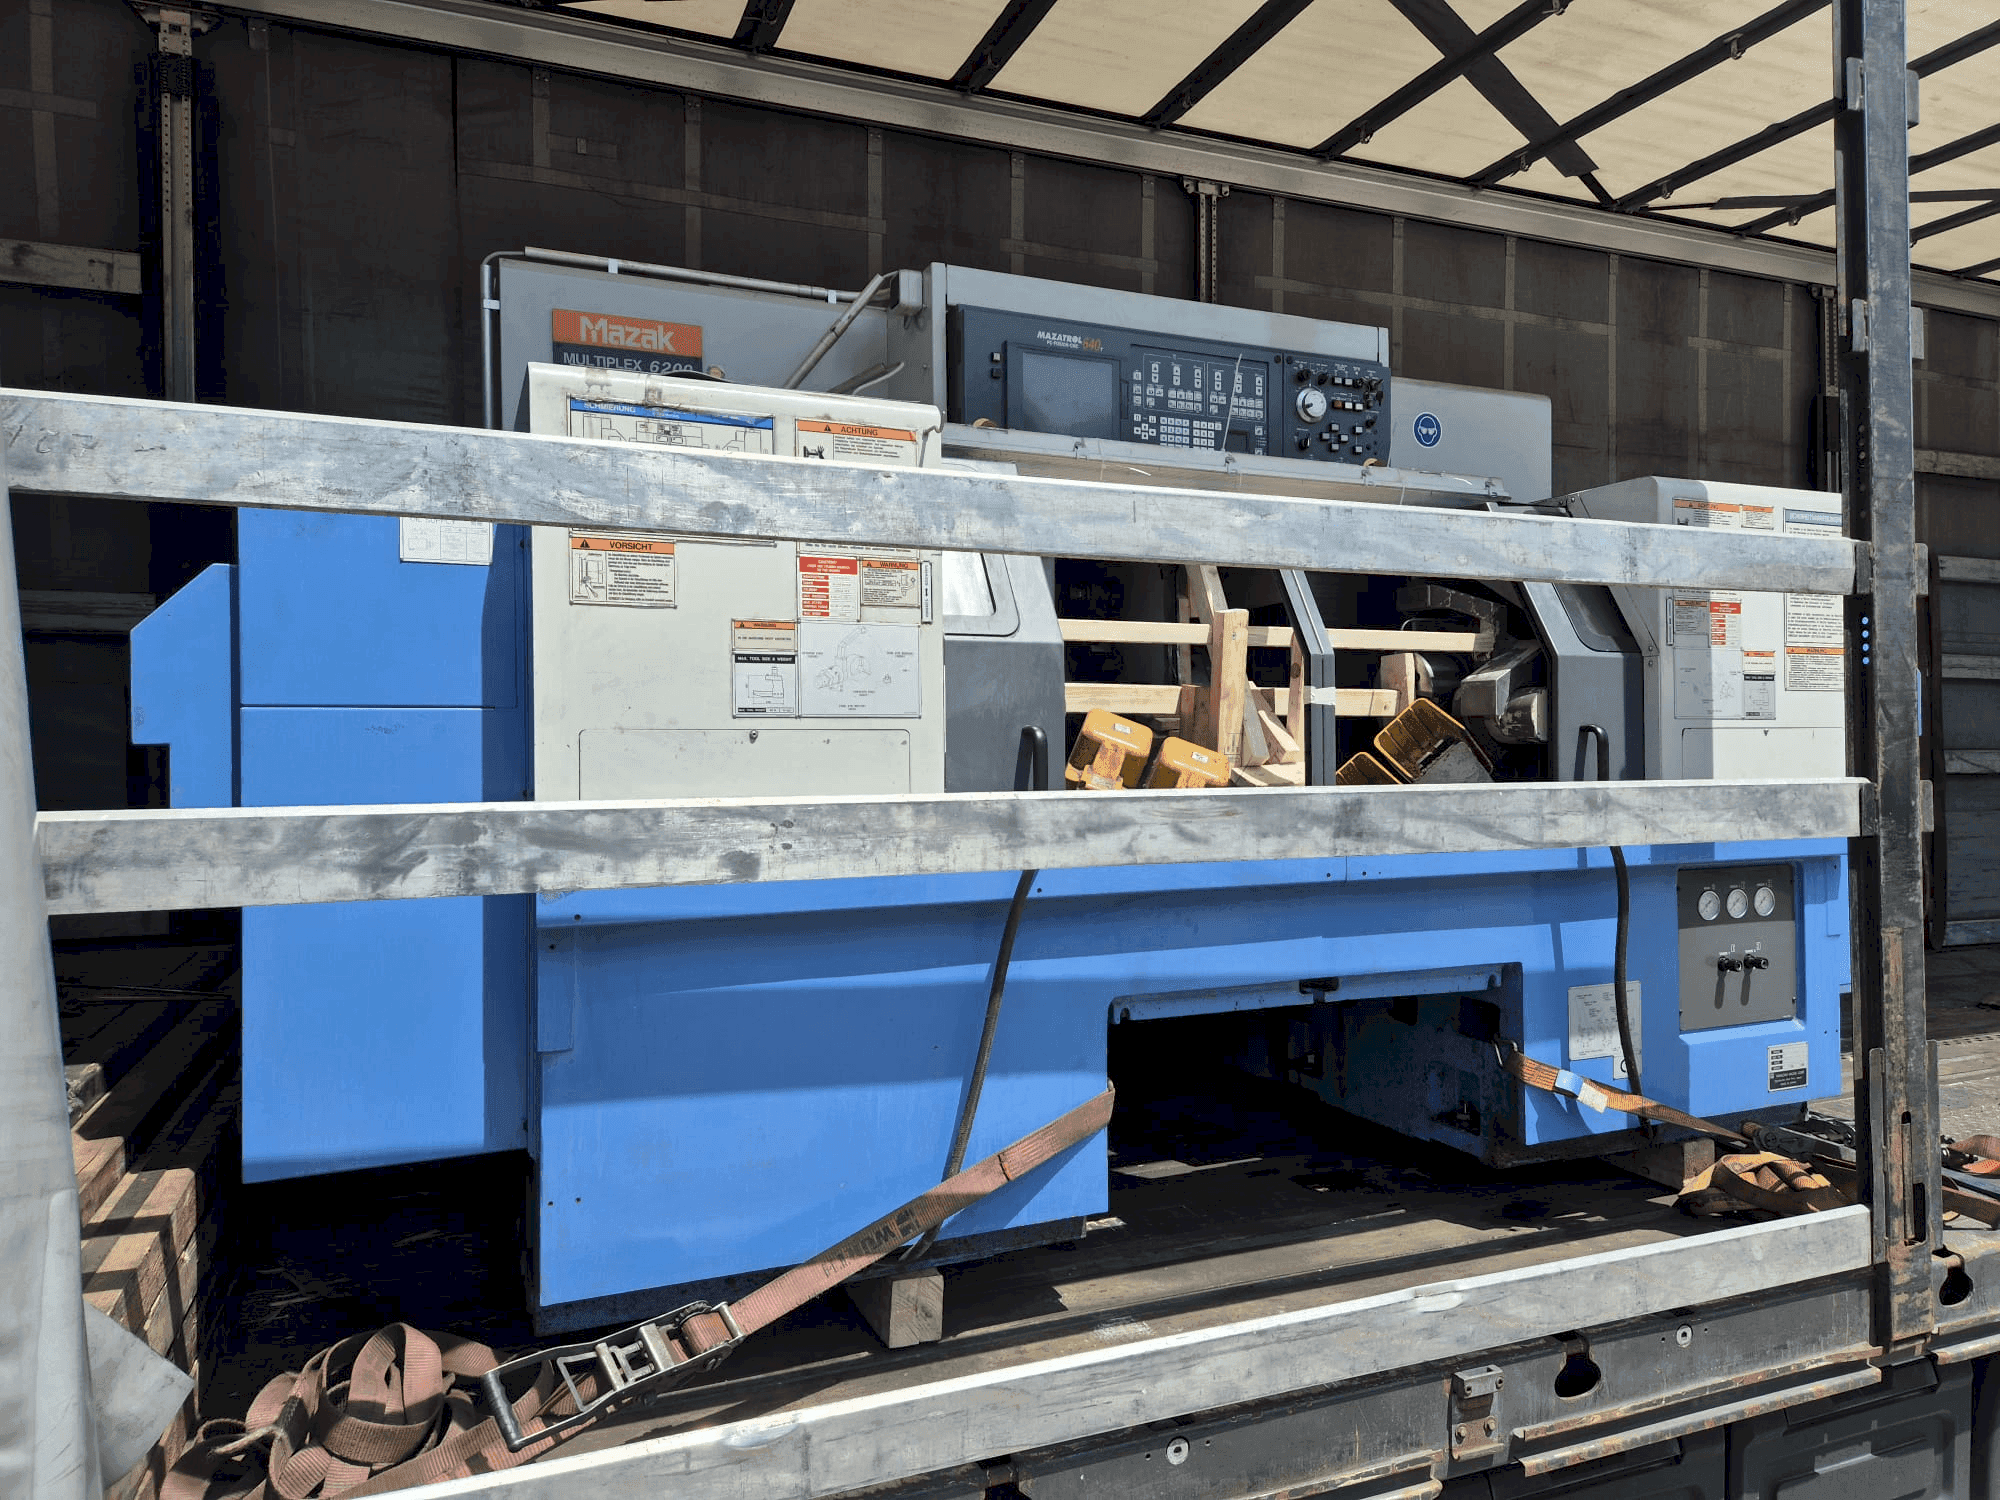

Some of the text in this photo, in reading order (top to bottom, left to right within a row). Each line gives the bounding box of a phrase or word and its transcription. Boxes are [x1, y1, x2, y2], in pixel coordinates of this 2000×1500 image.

[579, 315, 676, 352] Mazak
[1037, 330, 1082, 344] MAZATROL
[563, 352, 642, 371] MULTIPLEX
[841, 426, 878, 436] ACHTUNG
[609, 541, 653, 551] VORSICHT
